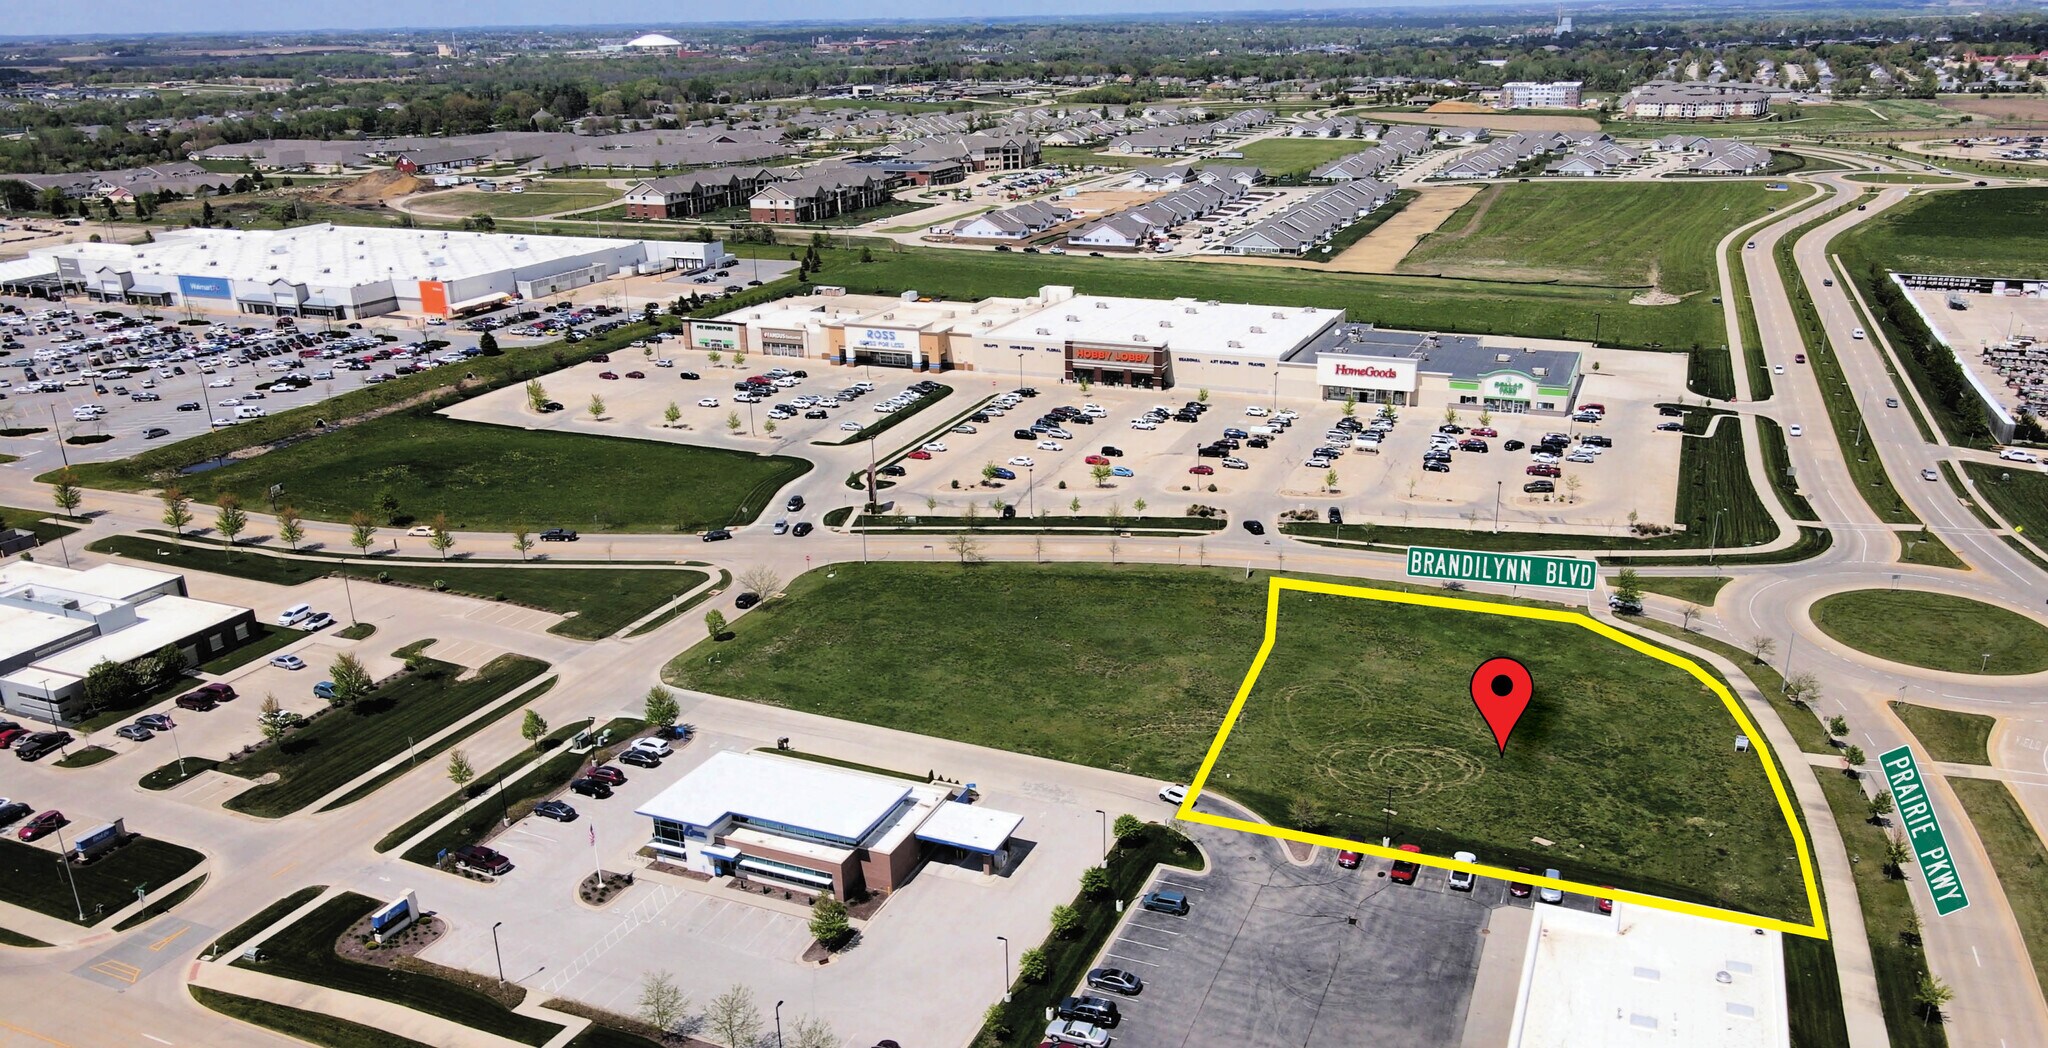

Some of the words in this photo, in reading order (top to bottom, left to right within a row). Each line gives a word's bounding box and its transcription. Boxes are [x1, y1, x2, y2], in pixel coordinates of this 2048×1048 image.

[867, 329, 896, 341] ROSS
[1076, 349, 1112, 361] HOBBY
[1115, 352, 1150, 363] LOBBY
[1335, 364, 1397, 379] HomeGoods
